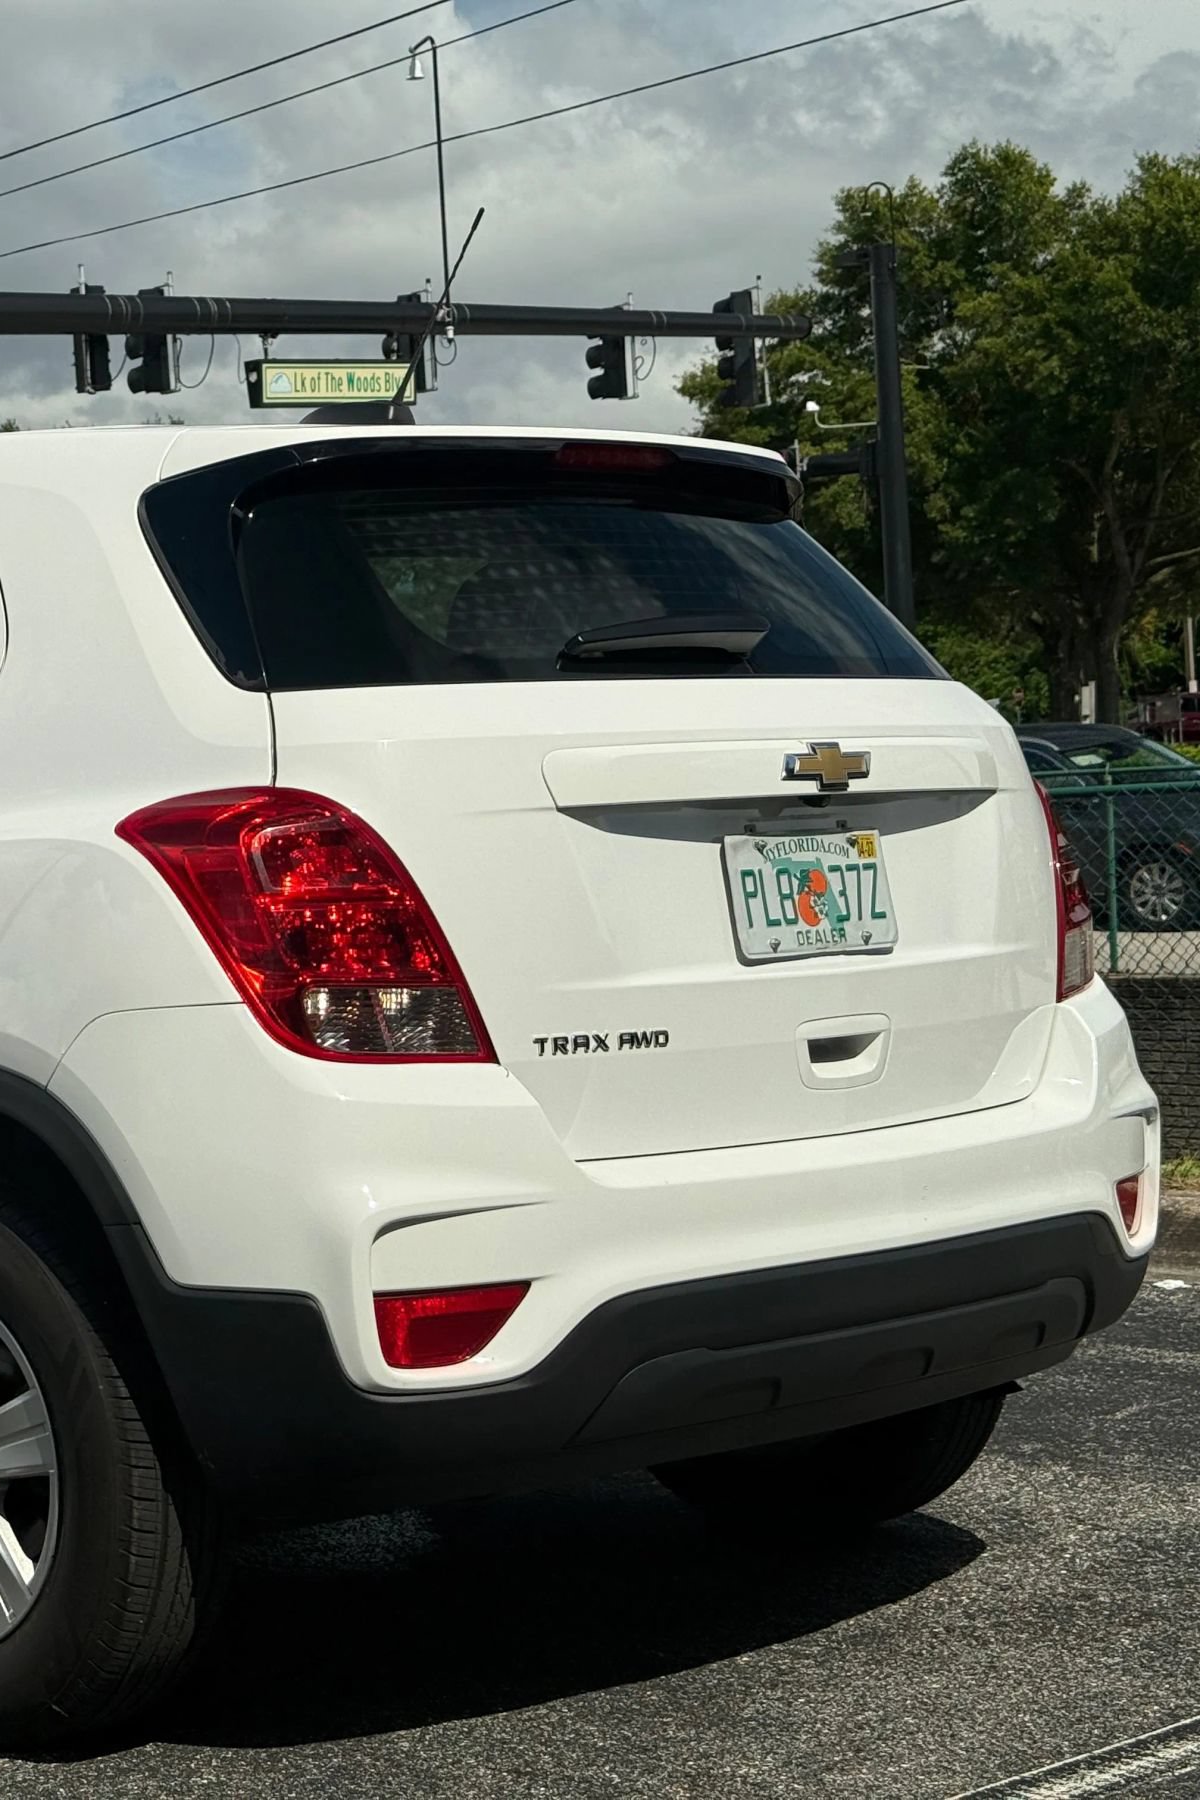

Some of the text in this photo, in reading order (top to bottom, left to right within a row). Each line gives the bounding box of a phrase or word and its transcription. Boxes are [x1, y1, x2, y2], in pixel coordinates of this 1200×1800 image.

[294, 371, 402, 392] Lk of The Woods Blv
[796, 928, 848, 946] DEALER
[532, 1029, 669, 1056] TRAX AWD
